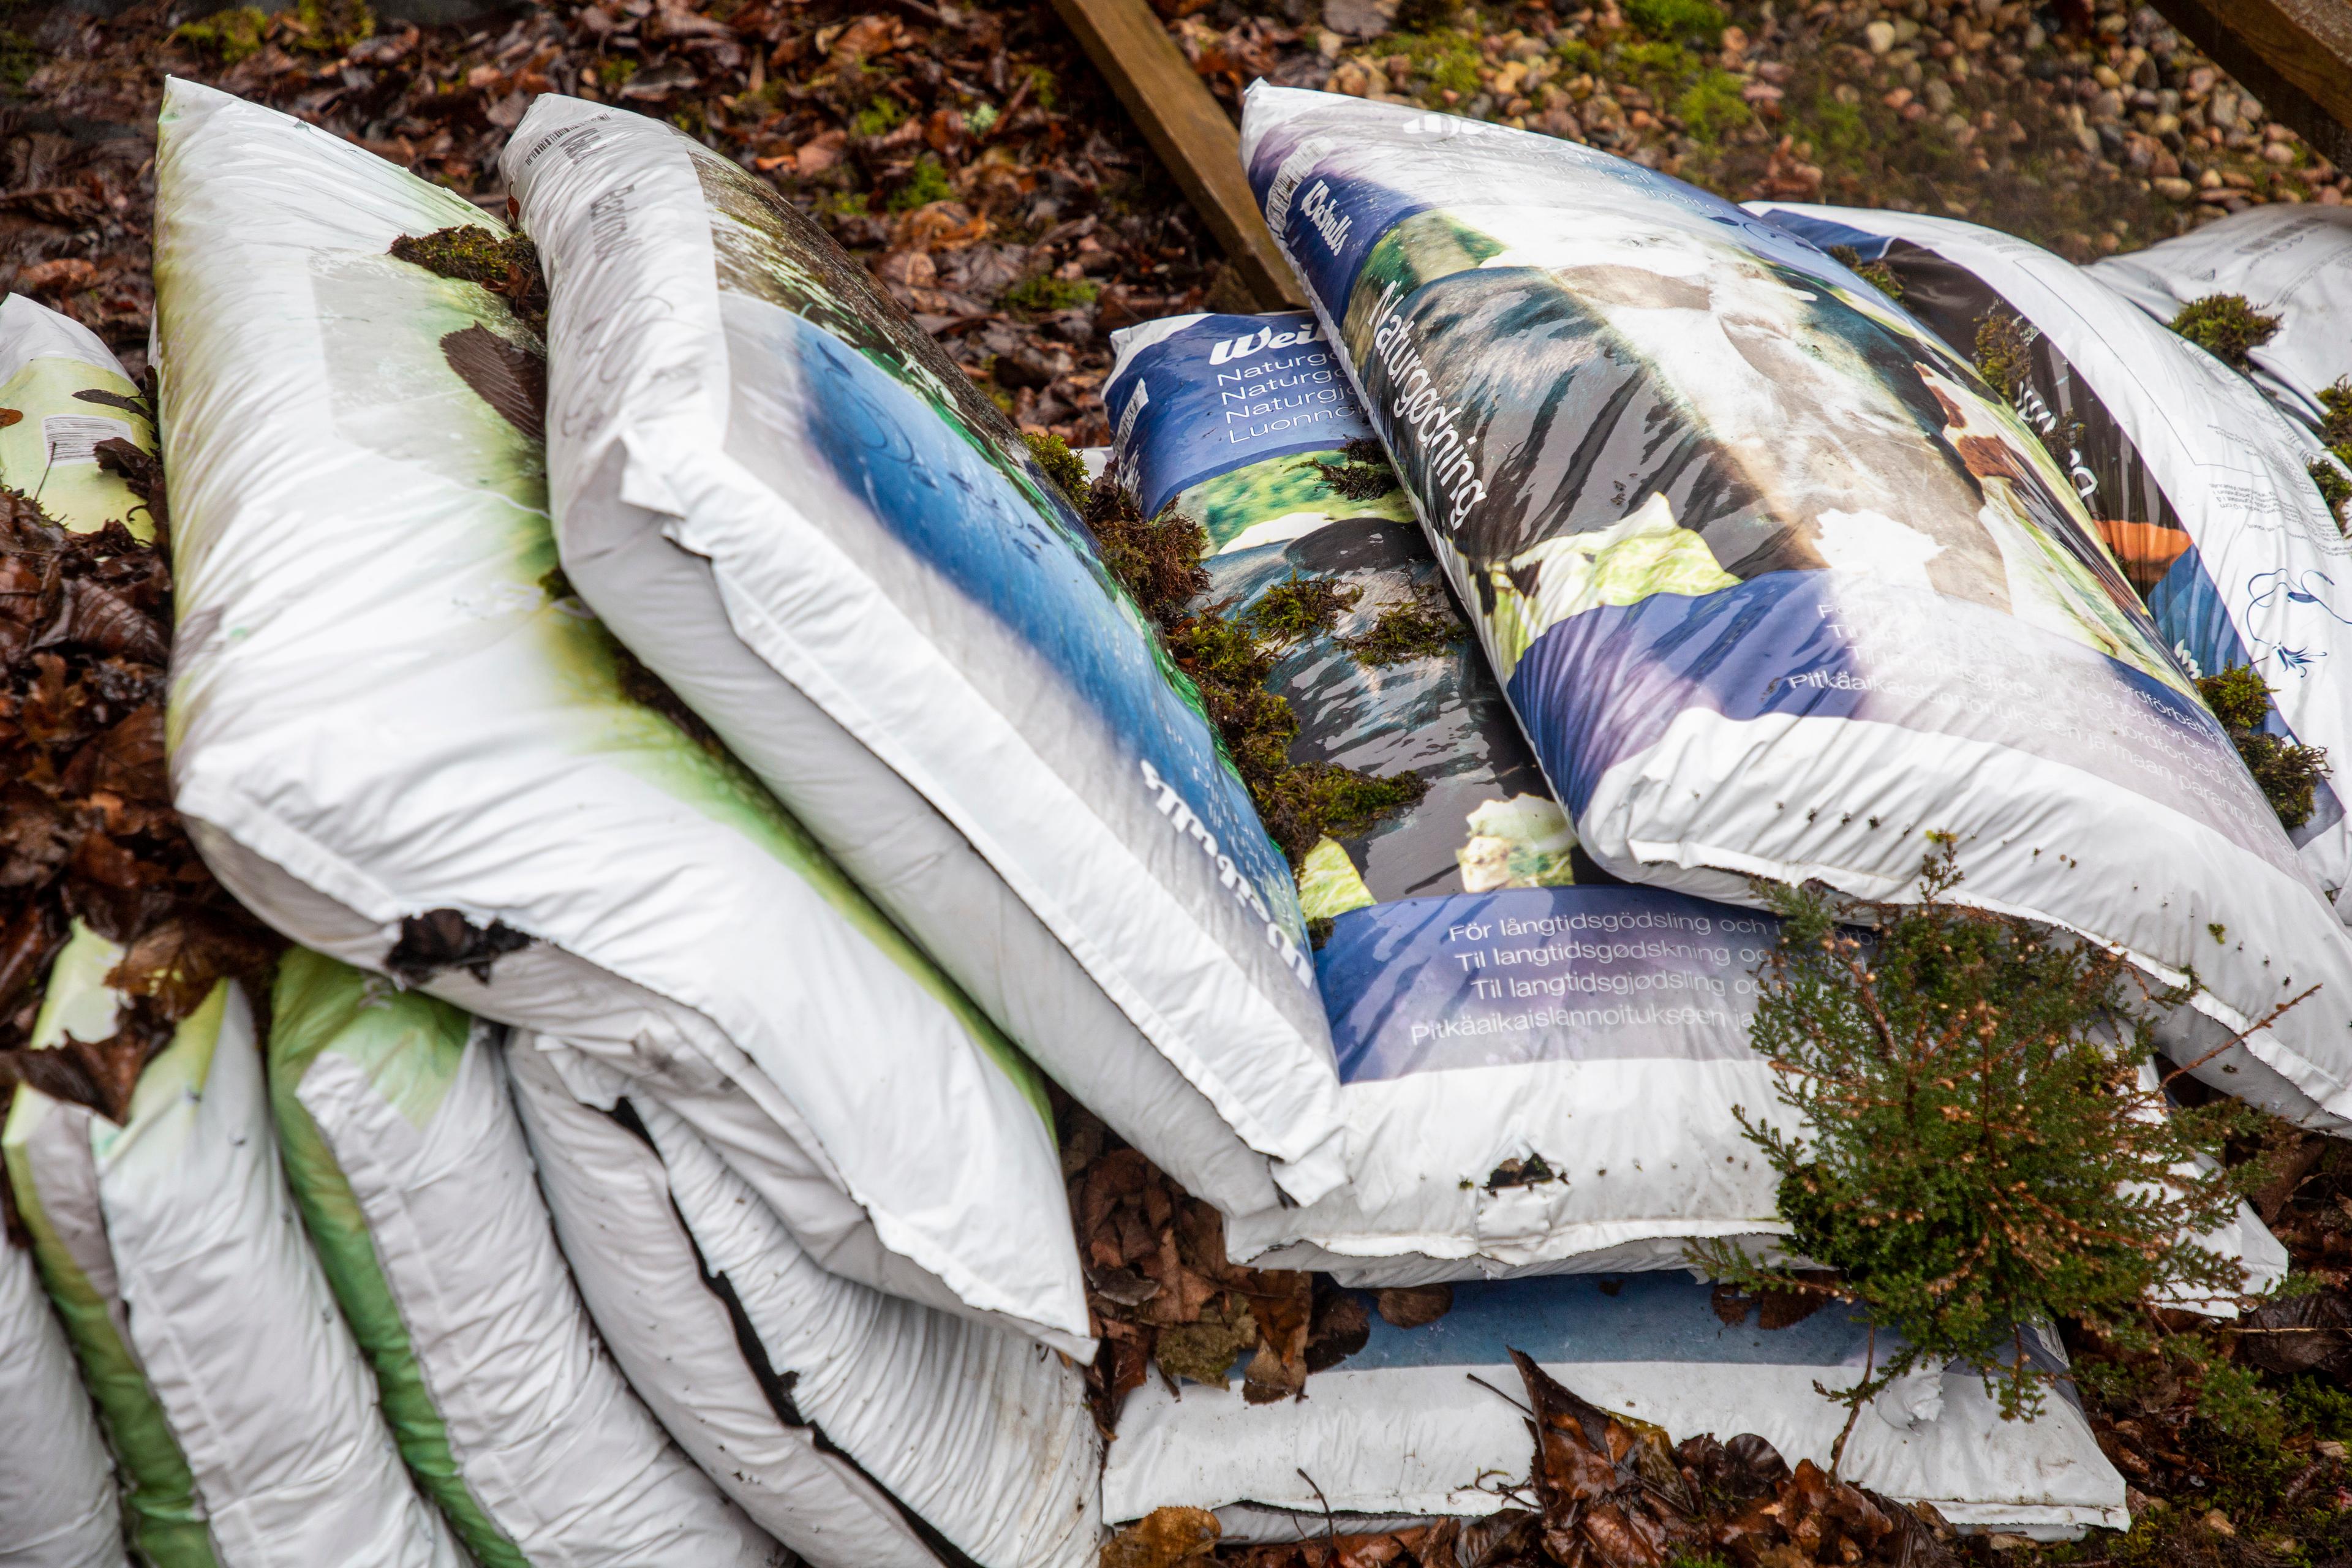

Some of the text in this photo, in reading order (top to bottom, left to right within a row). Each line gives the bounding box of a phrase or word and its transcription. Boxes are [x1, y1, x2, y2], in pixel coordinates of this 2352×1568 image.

[1367, 279, 1487, 532] Naturgødning
[2087, 729, 2108, 752] ja
[2114, 743, 2173, 782] maan
[1449, 922, 1492, 943] För
[1499, 911, 1712, 937] långtidsgödsling
[1719, 919, 1768, 935] och
[1454, 950, 1487, 972] Til
[1492, 940, 1732, 967] langtidsgødskning
[1470, 978, 1502, 1000] Til
[1509, 970, 1726, 998] langtidsgjødsling
[1410, 1003, 1726, 1046] Pitkäaikaislannoitukseen
